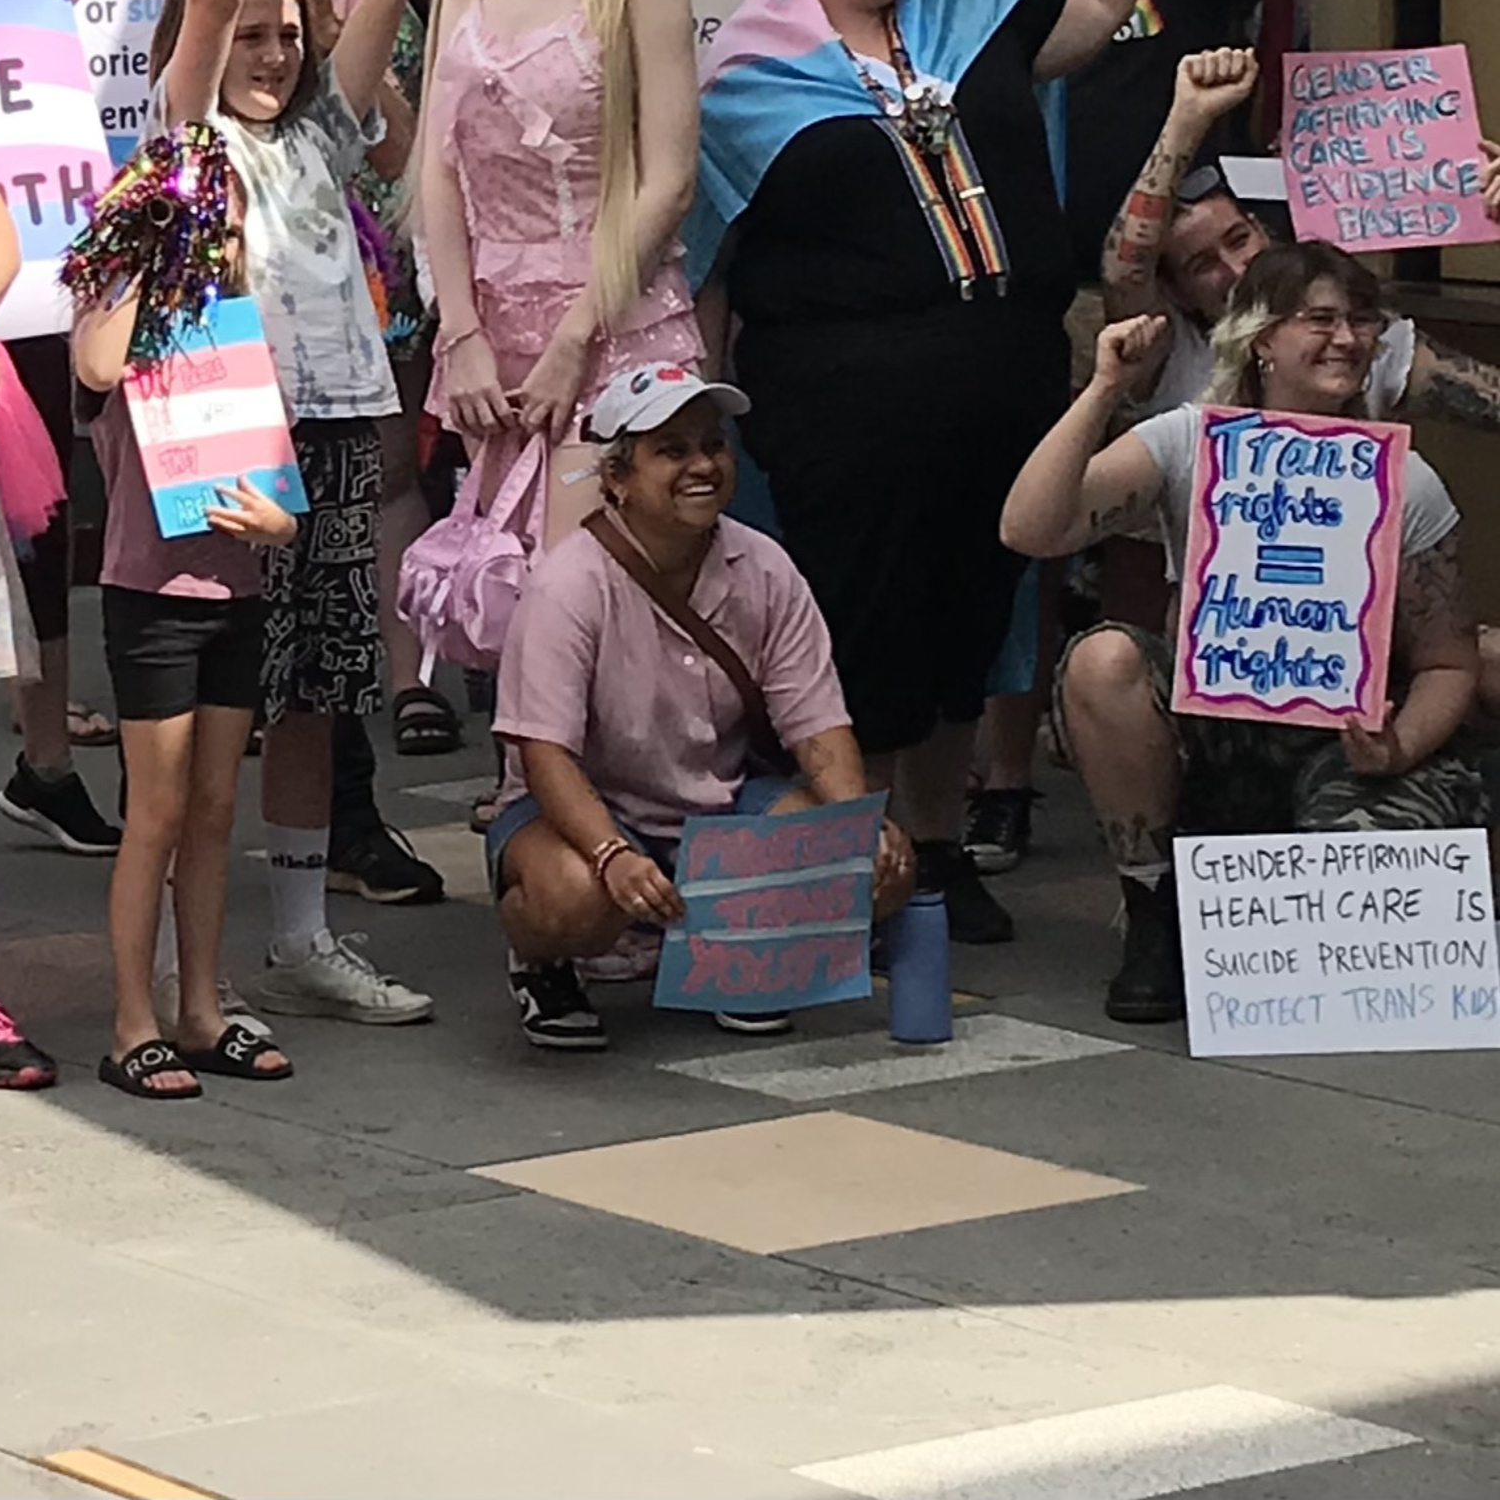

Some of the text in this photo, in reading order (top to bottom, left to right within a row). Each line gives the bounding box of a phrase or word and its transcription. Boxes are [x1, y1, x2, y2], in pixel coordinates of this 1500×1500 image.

[1291, 56, 1442, 104] GENDER
[1290, 90, 1462, 138] AFFIRMING
[1289, 128, 1426, 174] CARE IS
[1301, 158, 1482, 208] EVIDENCE
[1336, 201, 1460, 243] BASED
[1204, 412, 1377, 481] Trans
[1211, 479, 1344, 542] rights
[1192, 574, 1358, 638] Human
[1455, 888, 1487, 923] IS
[1204, 939, 1488, 979] SUICIDE PREVENTION
[1205, 983, 1499, 1035] PROTECT TRANS KIDS
